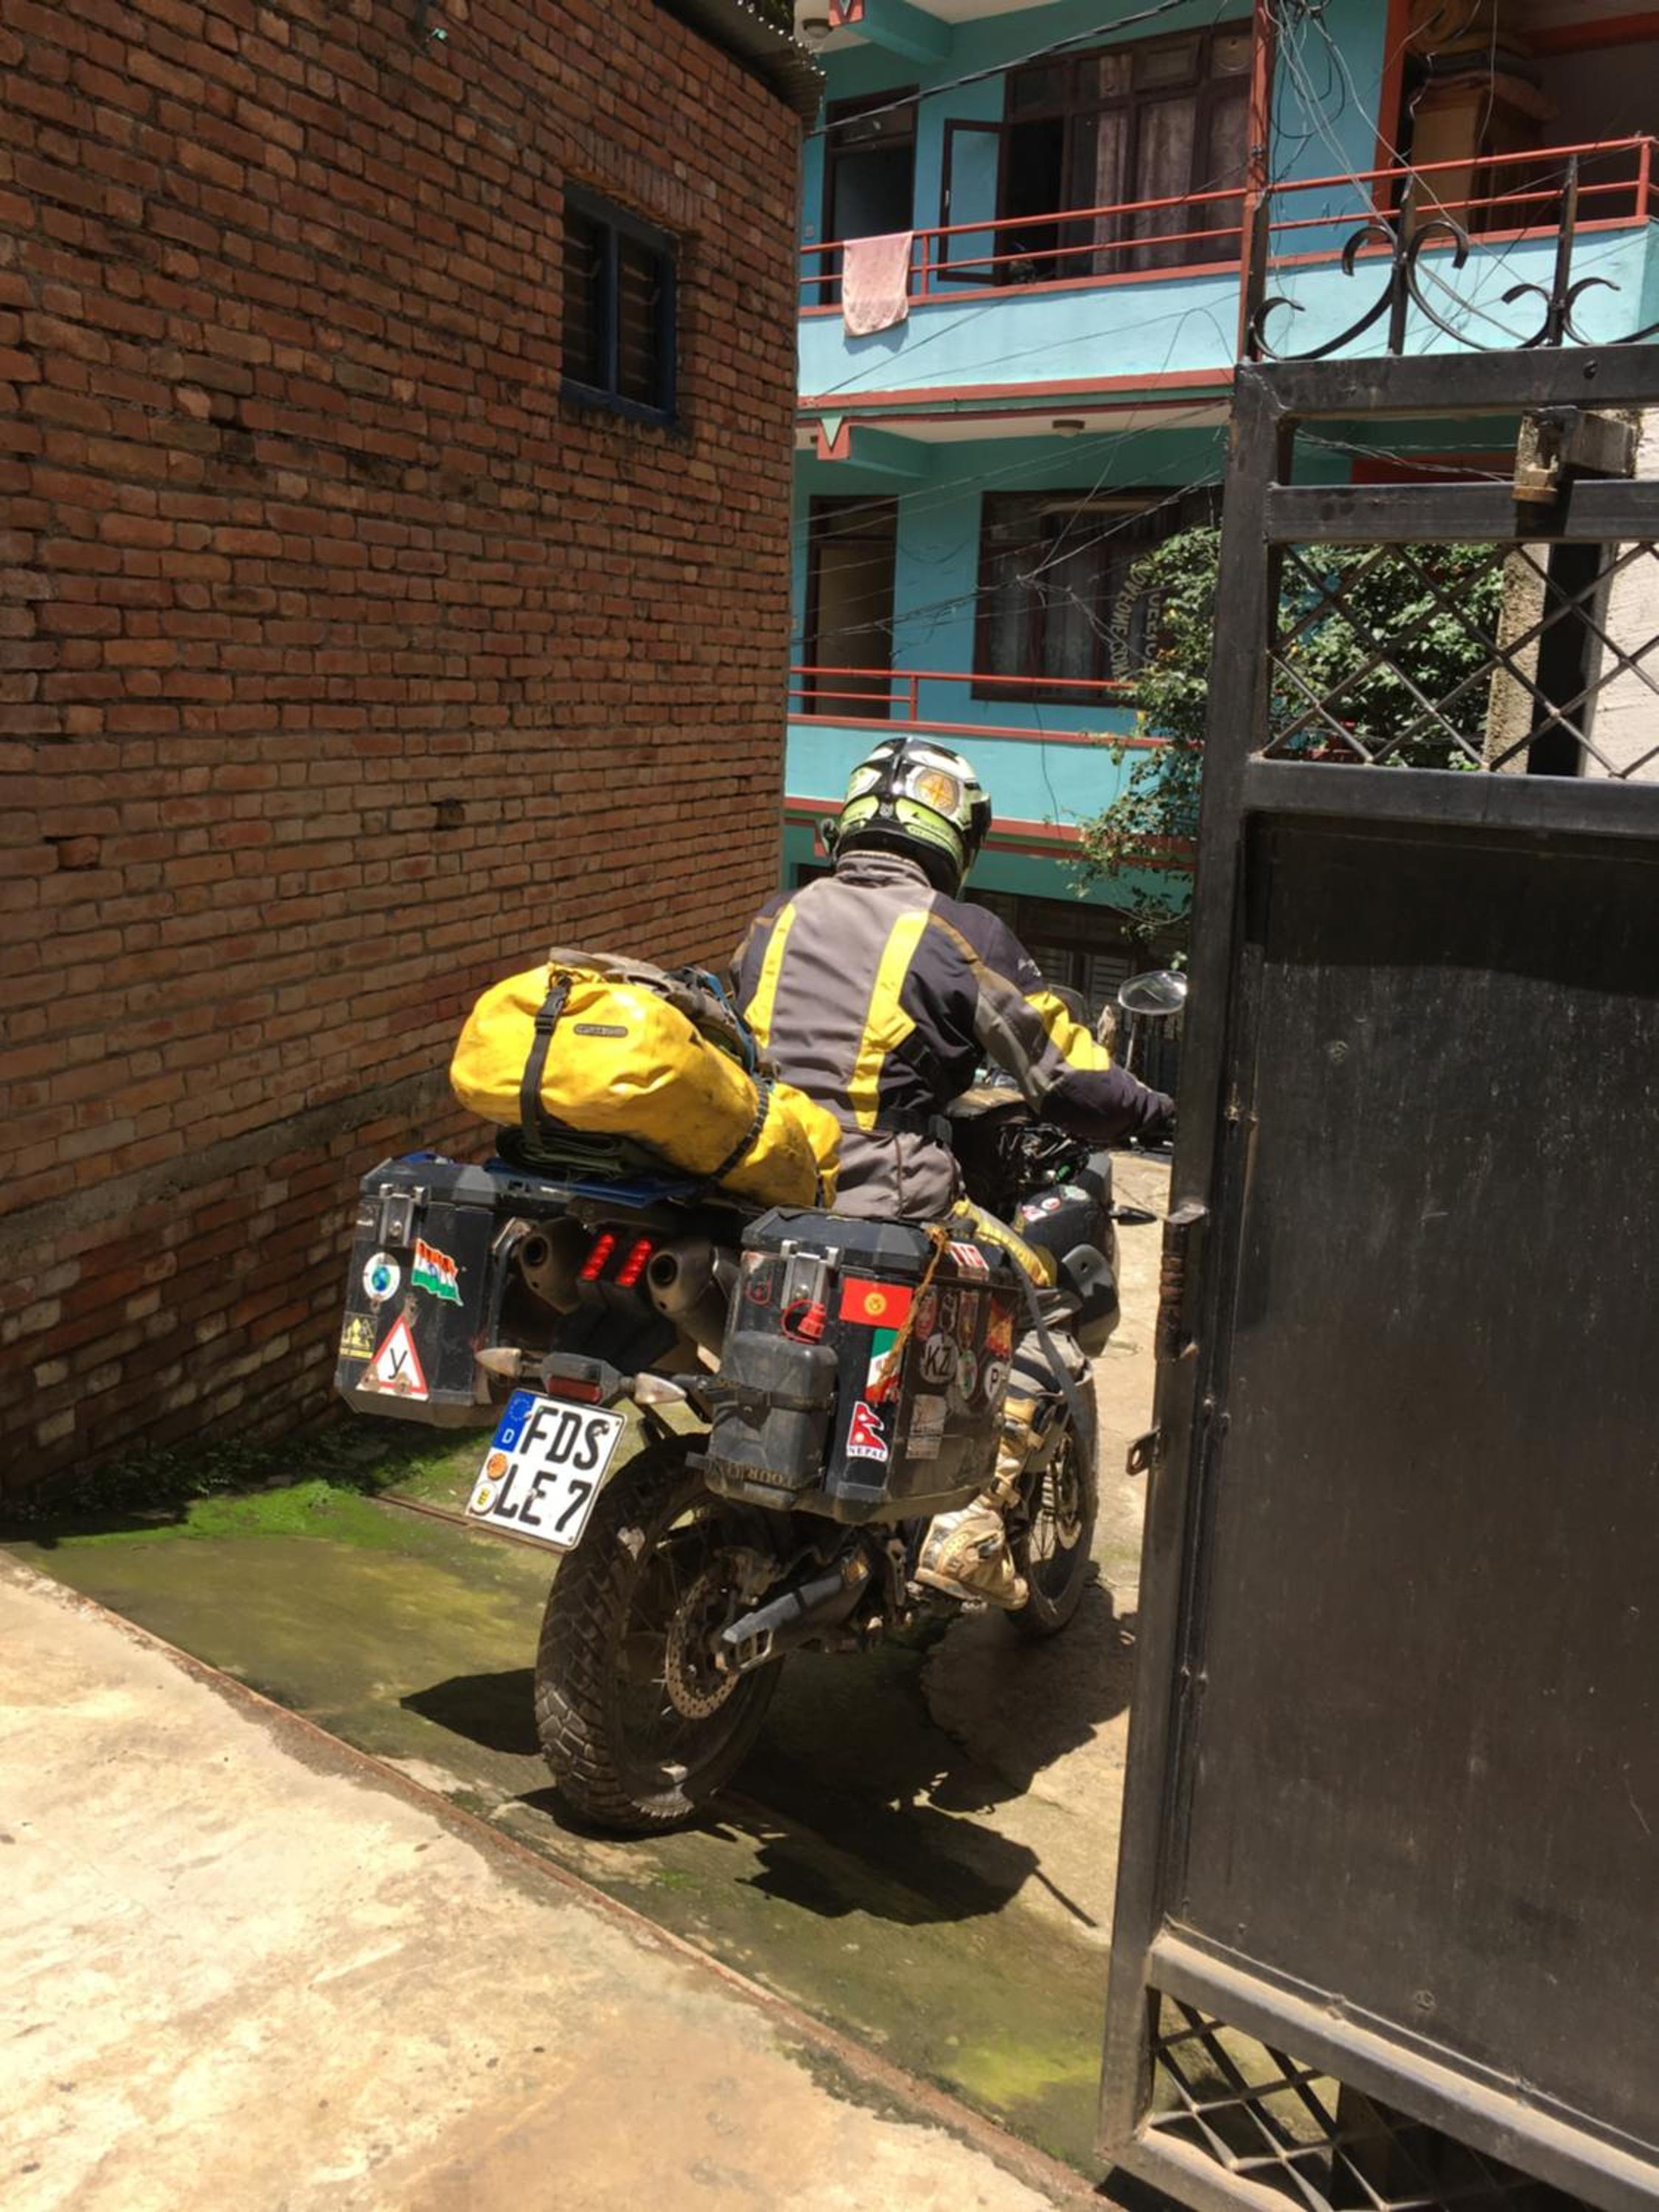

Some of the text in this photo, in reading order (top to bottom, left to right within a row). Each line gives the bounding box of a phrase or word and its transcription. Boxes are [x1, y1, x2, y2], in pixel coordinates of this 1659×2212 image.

[925, 1345, 952, 1376] KZ
[501, 1428, 515, 1444] D
[520, 1405, 610, 1471] FDS
[849, 1447, 883, 1458] NEPAL
[493, 1463, 592, 1532] LE 7
